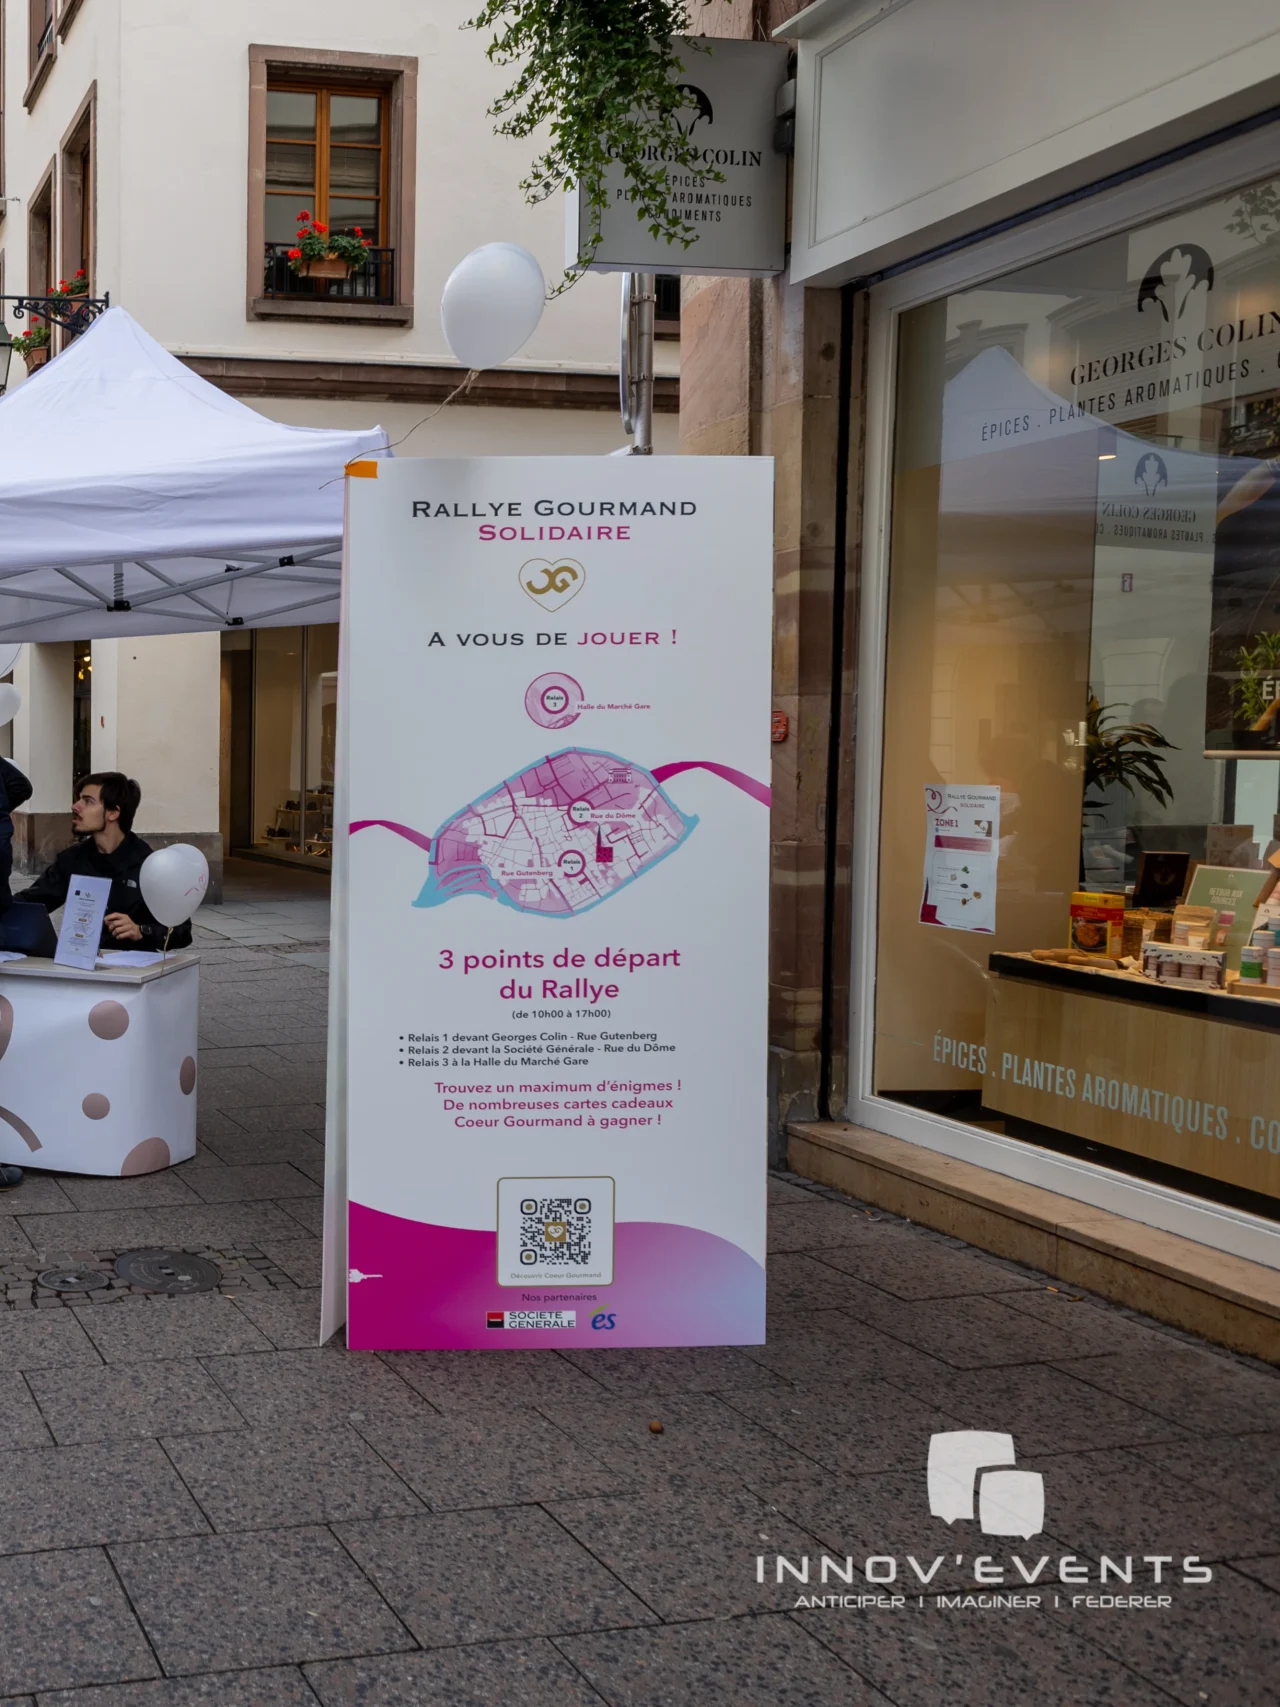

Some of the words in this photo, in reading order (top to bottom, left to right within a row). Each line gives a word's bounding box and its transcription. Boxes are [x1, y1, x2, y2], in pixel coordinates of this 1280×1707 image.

[703, 148, 762, 167] COLIN
[665, 172, 705, 188] ÉPICES
[672, 192, 752, 208] AROMATIQUES
[1070, 336, 1186, 386] GEORGES
[982, 415, 1030, 442] ÉPICES
[1049, 392, 1116, 425] PLANTES
[1124, 359, 1250, 407] AROMATIQUES
[412, 501, 522, 518] RALLYE
[534, 500, 697, 516] GOURMAND
[479, 524, 630, 541] SOLIDAIRE
[427, 631, 446, 647] A
[456, 633, 524, 646] VOUS
[536, 633, 567, 645] DE
[577, 632, 659, 645] JOUER
[935, 818, 954, 827] ZONE
[439, 949, 454, 969] 3
[464, 949, 545, 974] points
[553, 948, 586, 968] de
[594, 947, 681, 973] départ
[500, 979, 532, 999] du
[542, 978, 620, 1004] Rallye
[512, 1010, 529, 1020] (de
[532, 1010, 564, 1019] 10h00
[566, 1009, 573, 1018] à
[575, 1009, 611, 1019] 17h00)
[408, 1033, 440, 1043] Relais
[443, 1033, 448, 1042] 1
[452, 1033, 489, 1042] devant
[492, 1032, 537, 1044] Georges
[540, 1032, 568, 1042] Colin
[577, 1032, 597, 1041] Rue
[600, 1031, 658, 1043] Gutenberg
[408, 1045, 440, 1055] Relais
[442, 1045, 449, 1055] 2
[452, 1045, 489, 1055] devant
[491, 1045, 501, 1054] la
[504, 1044, 543, 1054] Société
[545, 1044, 595, 1054] Générale
[604, 1044, 624, 1053] Rue
[626, 1043, 641, 1053] du
[643, 1043, 676, 1053] Dôme
[408, 1057, 440, 1067] Relais
[442, 1057, 449, 1067] 3
[452, 1057, 458, 1066] à
[461, 1057, 471, 1066] la
[473, 1057, 501, 1066] Halle
[503, 1057, 518, 1066] du
[520, 1056, 560, 1066] Marché
[563, 1057, 589, 1065] Gare
[434, 1082, 492, 1094] Trouvez
[496, 1084, 515, 1093] un
[519, 1081, 592, 1093] maximum
[596, 1080, 673, 1095] d'énigmes
[933, 1029, 987, 1075] ÉPICES
[1002, 1052, 1076, 1099] PLANTES
[1081, 1072, 1228, 1141] AROMATIQUES
[443, 1100, 465, 1111] De
[469, 1099, 560, 1110] nombreuses
[563, 1099, 608, 1109] cartes
[611, 1097, 673, 1109] cadeaux
[454, 1116, 499, 1128] Coeur
[503, 1114, 583, 1127] Gourmand
[587, 1115, 595, 1126] à
[600, 1116, 653, 1129] gagner
[544, 1293, 597, 1302] partenaires
[509, 1320, 575, 1328] GENERALE
